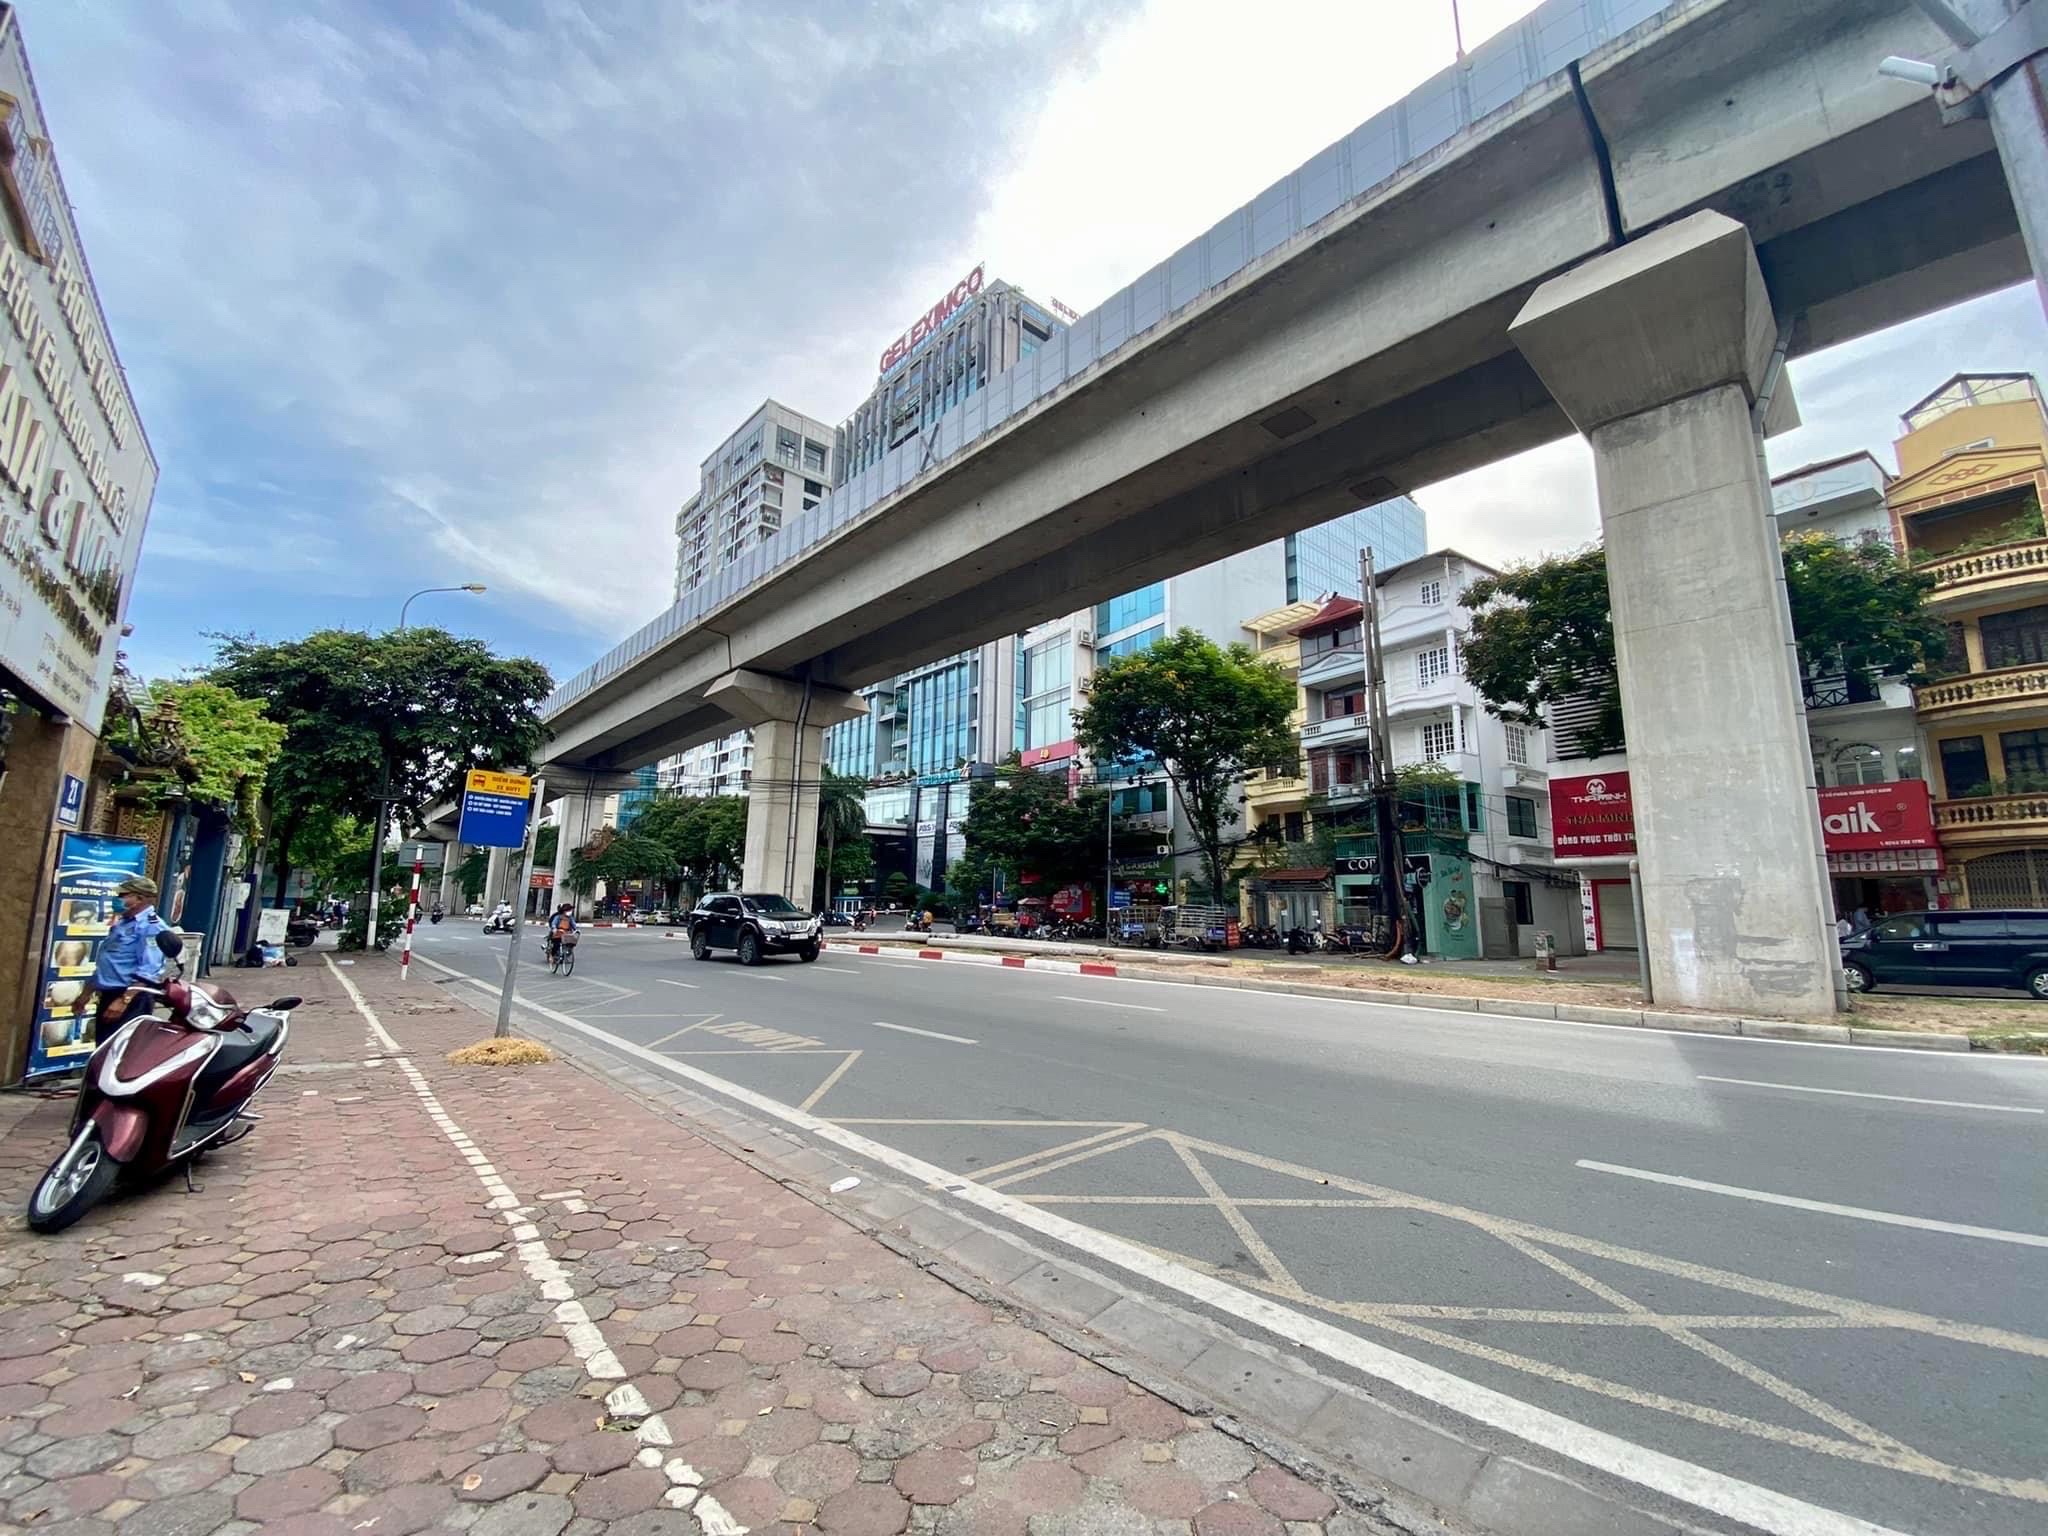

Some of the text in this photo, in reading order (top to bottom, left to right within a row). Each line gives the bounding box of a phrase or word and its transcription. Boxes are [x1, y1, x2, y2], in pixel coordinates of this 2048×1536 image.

[54, 245, 130, 449] PHÒNG KHÁM
[57, 380, 96, 474] KHOA
